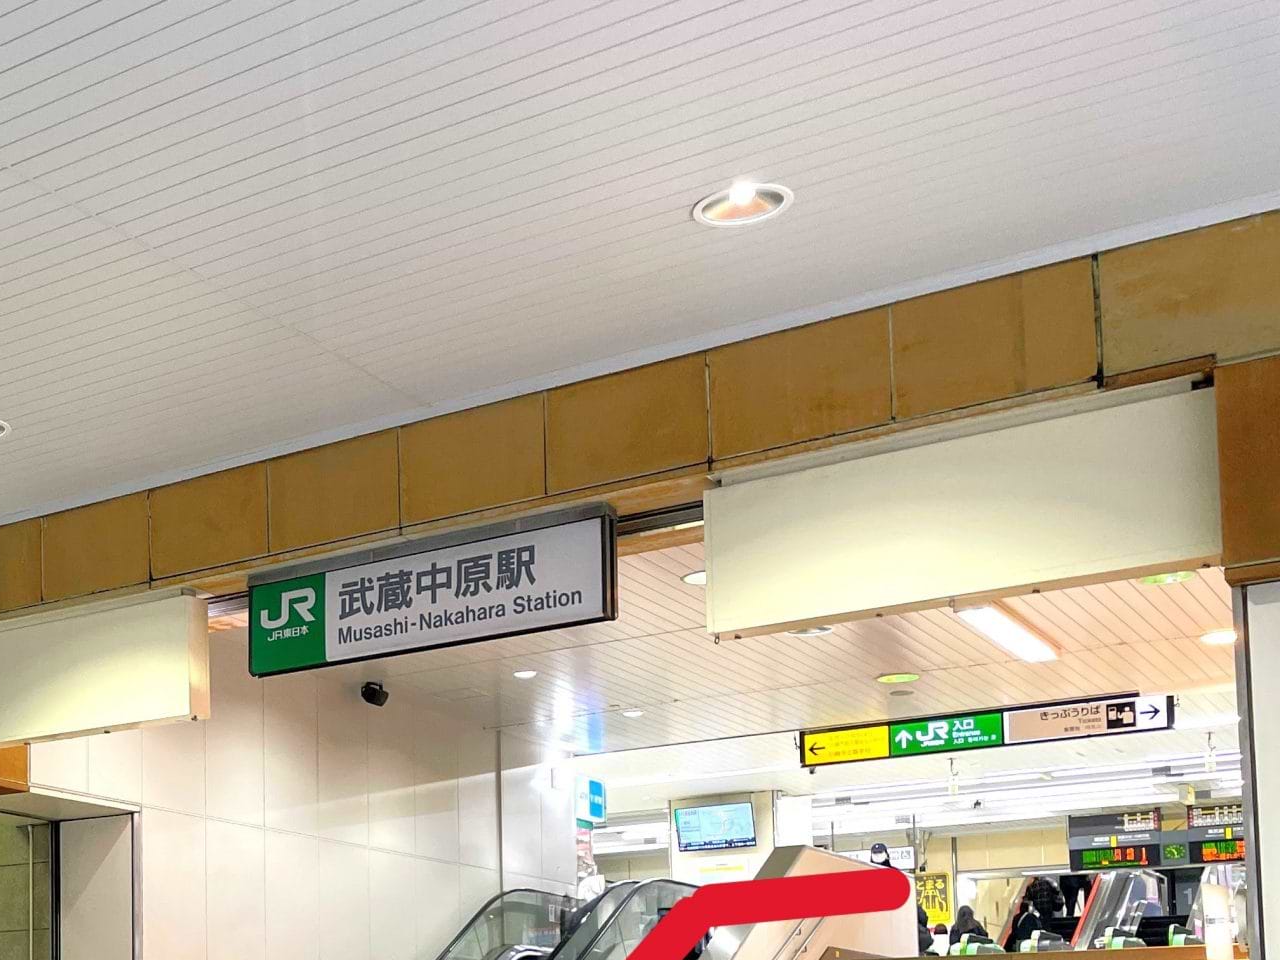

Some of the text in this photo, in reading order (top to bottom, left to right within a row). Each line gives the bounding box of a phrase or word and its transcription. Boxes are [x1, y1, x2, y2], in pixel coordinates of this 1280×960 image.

[338, 544, 536, 620] 武蔵中原駅
[260, 587, 316, 629] JR
[338, 590, 583, 644] Musashi-Nakahara Station
[267, 625, 309, 641] JR東日本
[1040, 704, 1101, 721] きっぷうりば
[916, 721, 949, 742] JR
[952, 719, 974, 731] 入口
